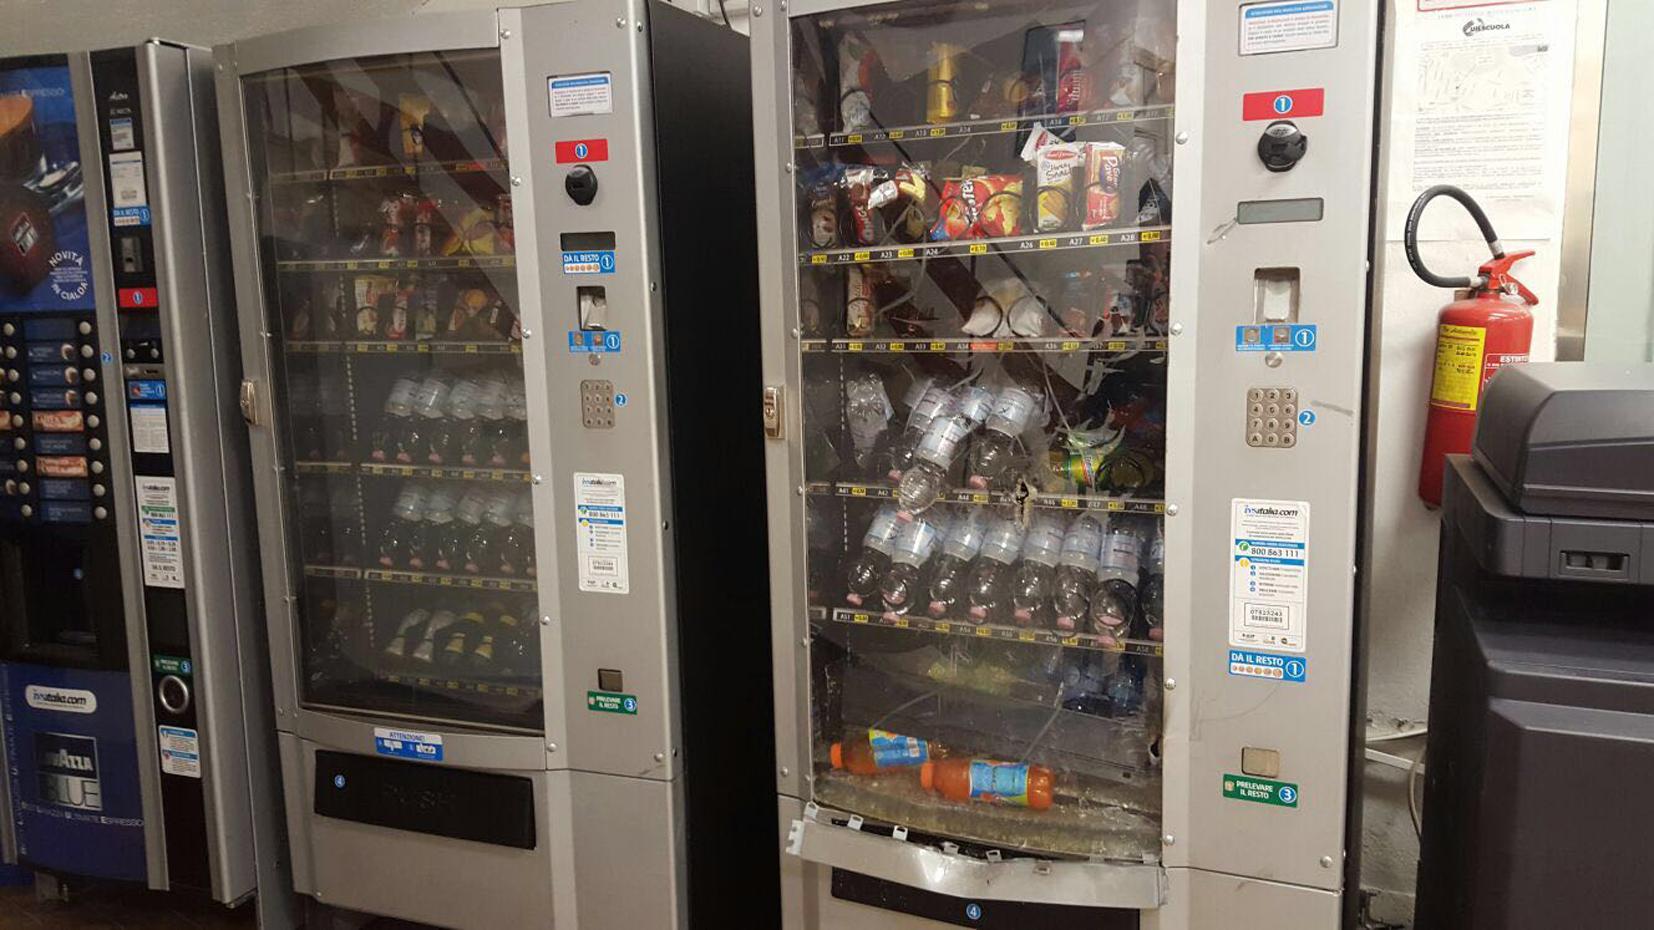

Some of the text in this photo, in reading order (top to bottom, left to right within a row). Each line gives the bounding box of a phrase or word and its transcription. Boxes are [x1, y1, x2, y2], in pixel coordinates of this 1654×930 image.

[838, 253, 850, 261] A22
[1250, 547, 1266, 556] 800
[1285, 549, 1299, 558] 111
[1246, 653, 1254, 663] IL
[1255, 655, 1284, 667] RESTO
[1236, 780, 1274, 793] PRELEVARE
[1247, 789, 1269, 799] RESTO
